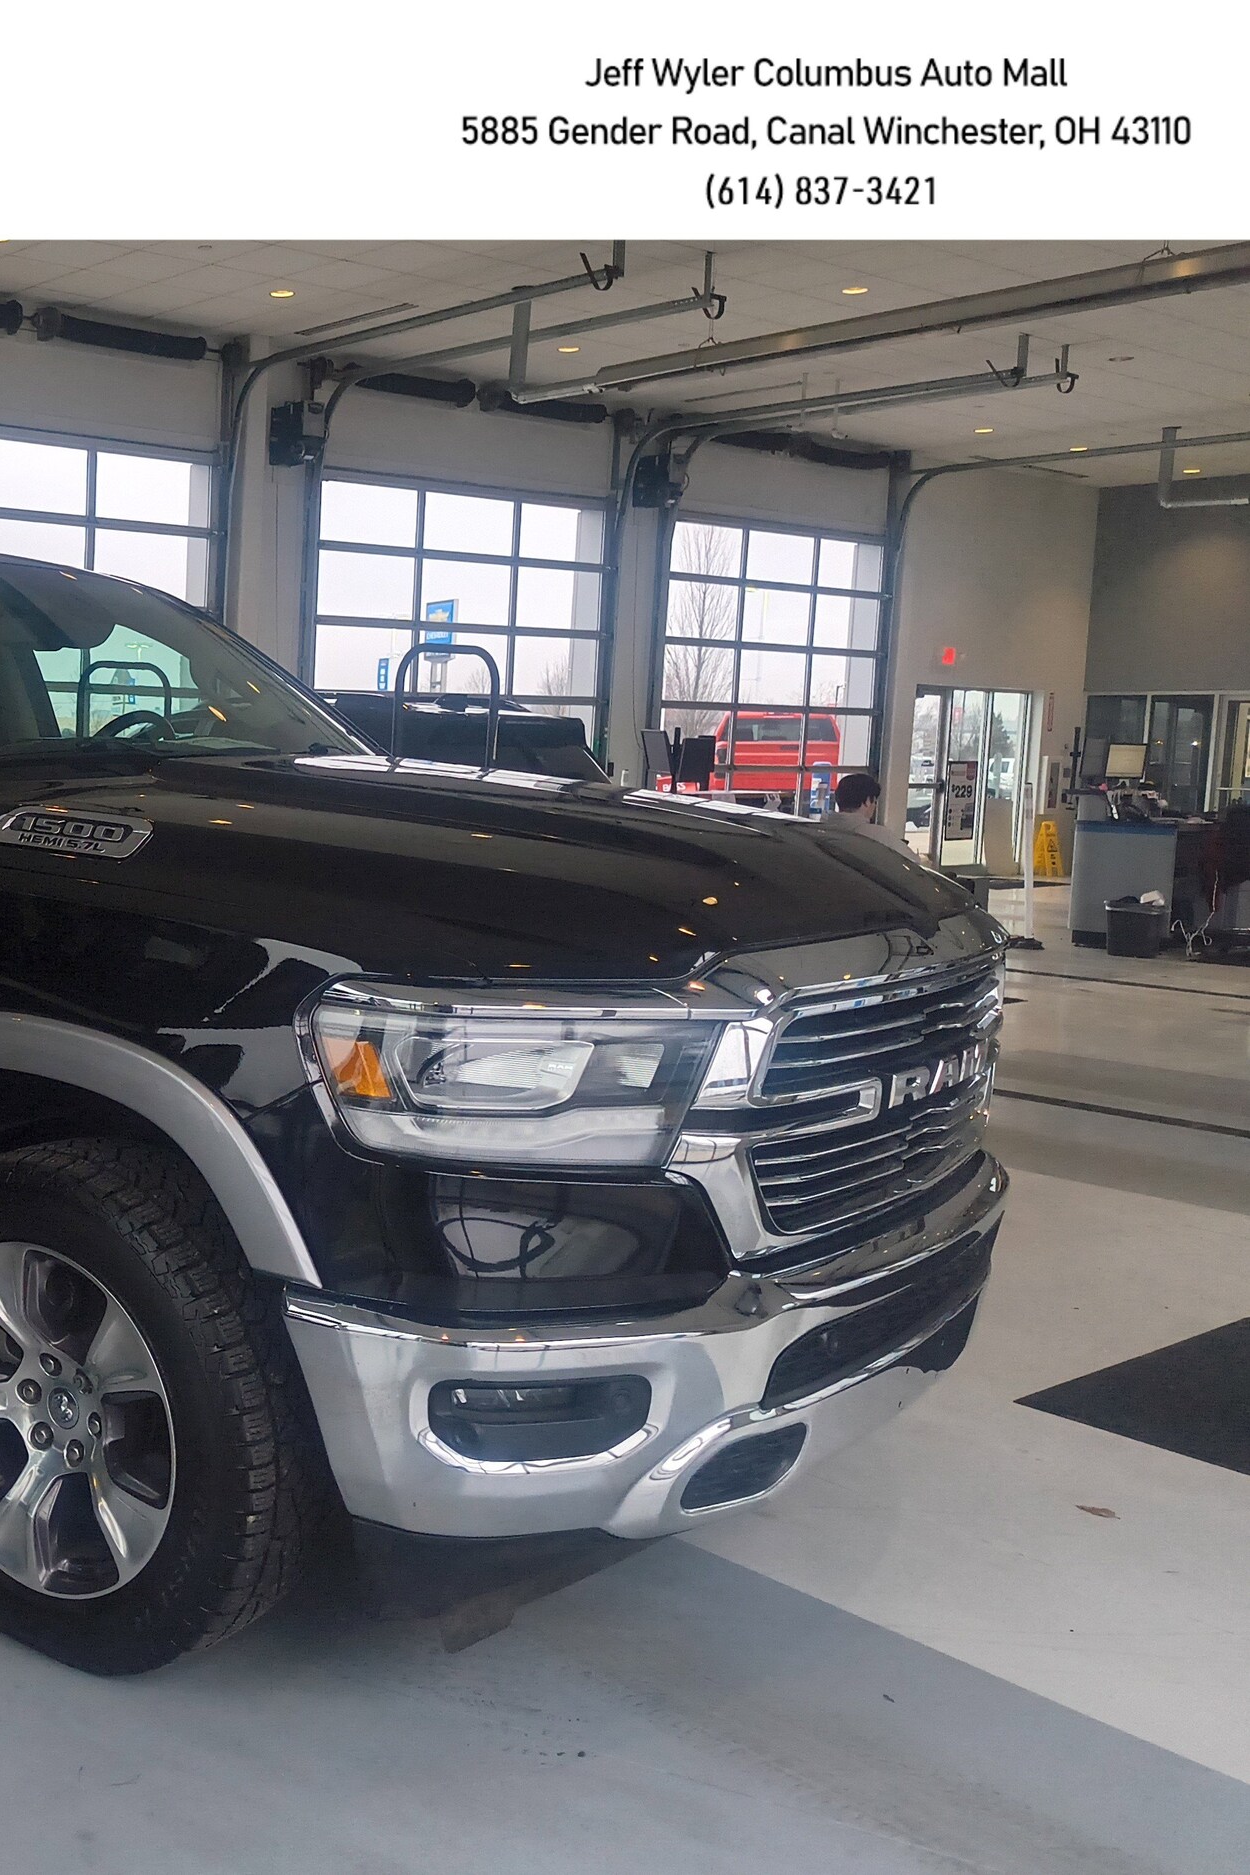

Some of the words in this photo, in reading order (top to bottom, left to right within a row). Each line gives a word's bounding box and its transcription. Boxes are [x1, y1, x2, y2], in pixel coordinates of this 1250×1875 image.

[951, 784, 973, 798] $229
[20, 815, 125, 842] 1500
[18, 832, 66, 849] HEMI
[65, 838, 106, 854] 5.7L
[888, 1043, 989, 1109] RAM
